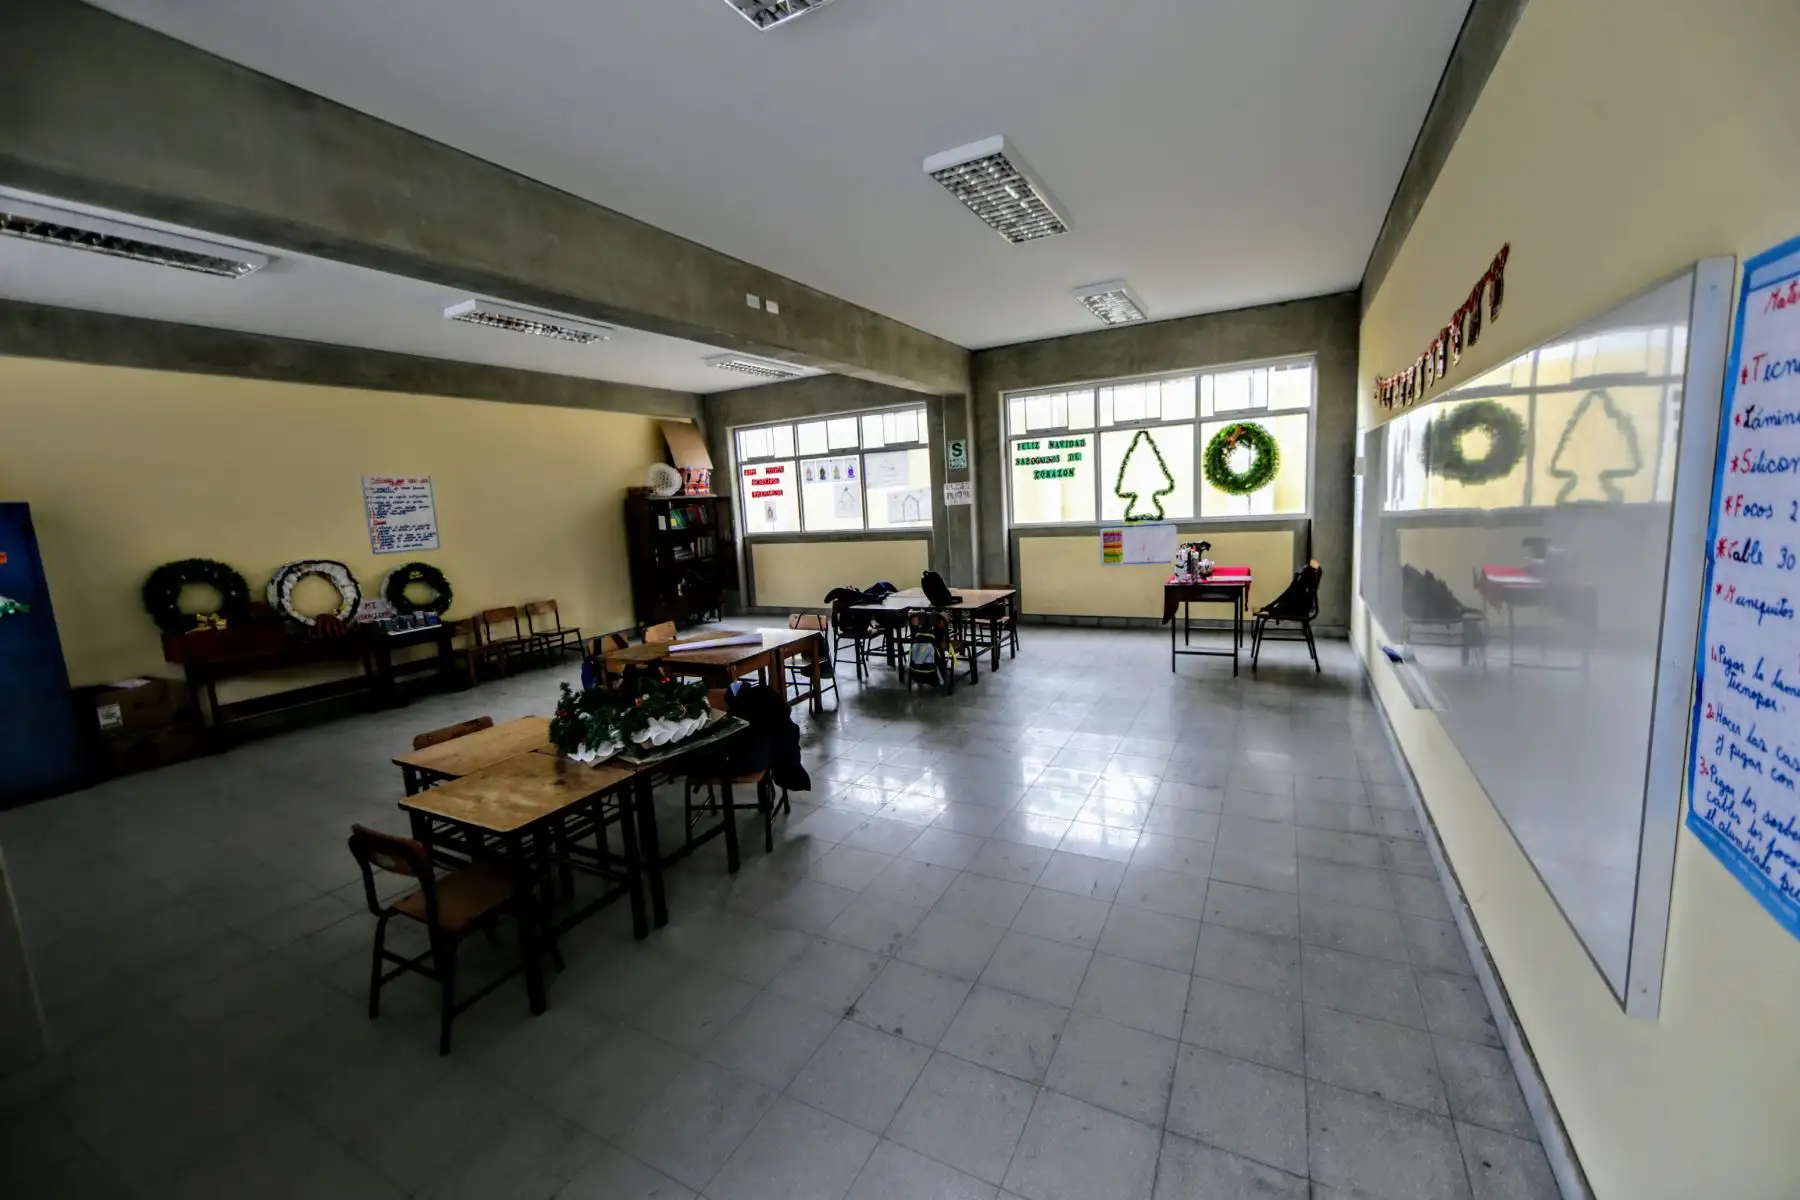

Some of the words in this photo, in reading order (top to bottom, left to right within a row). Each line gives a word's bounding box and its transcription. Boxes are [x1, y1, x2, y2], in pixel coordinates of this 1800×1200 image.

[952, 442, 963, 457] S
[1016, 441, 1040, 451] FELIZ
[1048, 438, 1086, 449] NAVIDAD
